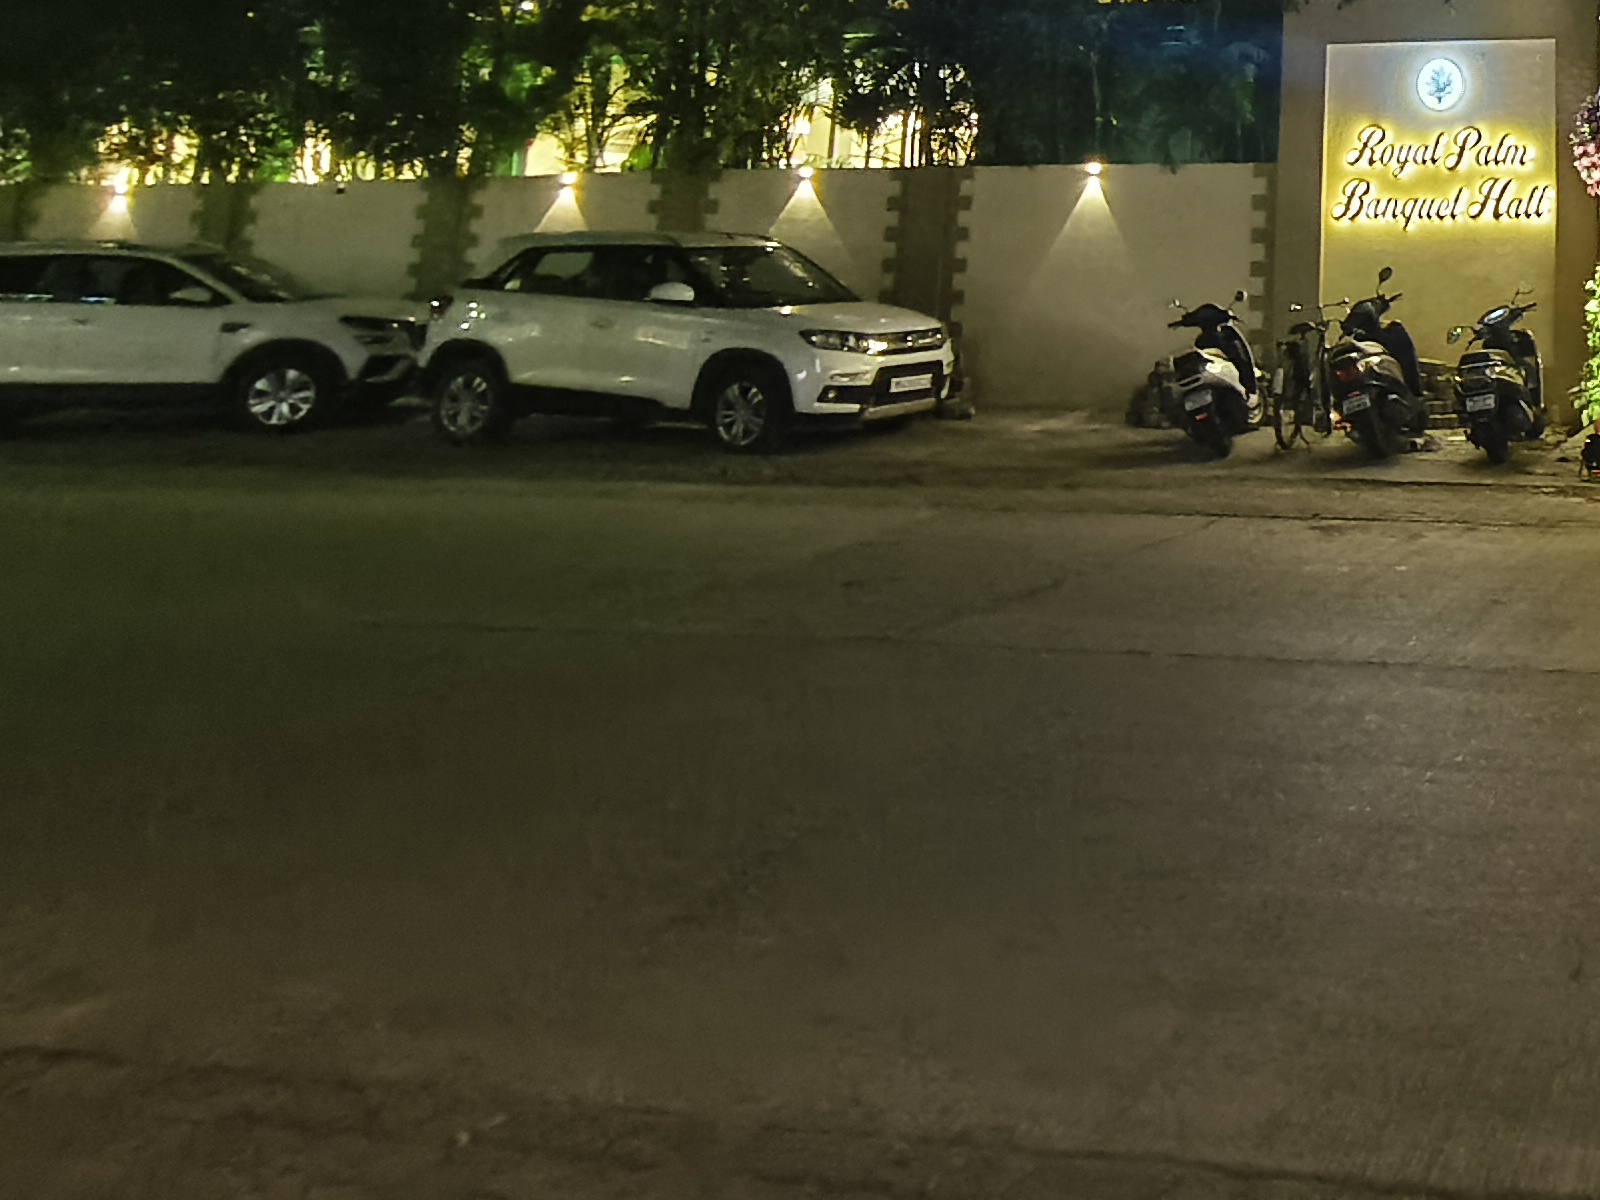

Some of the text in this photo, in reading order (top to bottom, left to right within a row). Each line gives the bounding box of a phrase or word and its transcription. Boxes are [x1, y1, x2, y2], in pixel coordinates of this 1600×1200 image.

[1346, 123, 1535, 179] Royal Palm
[1331, 176, 1553, 232] Banquet Hall
